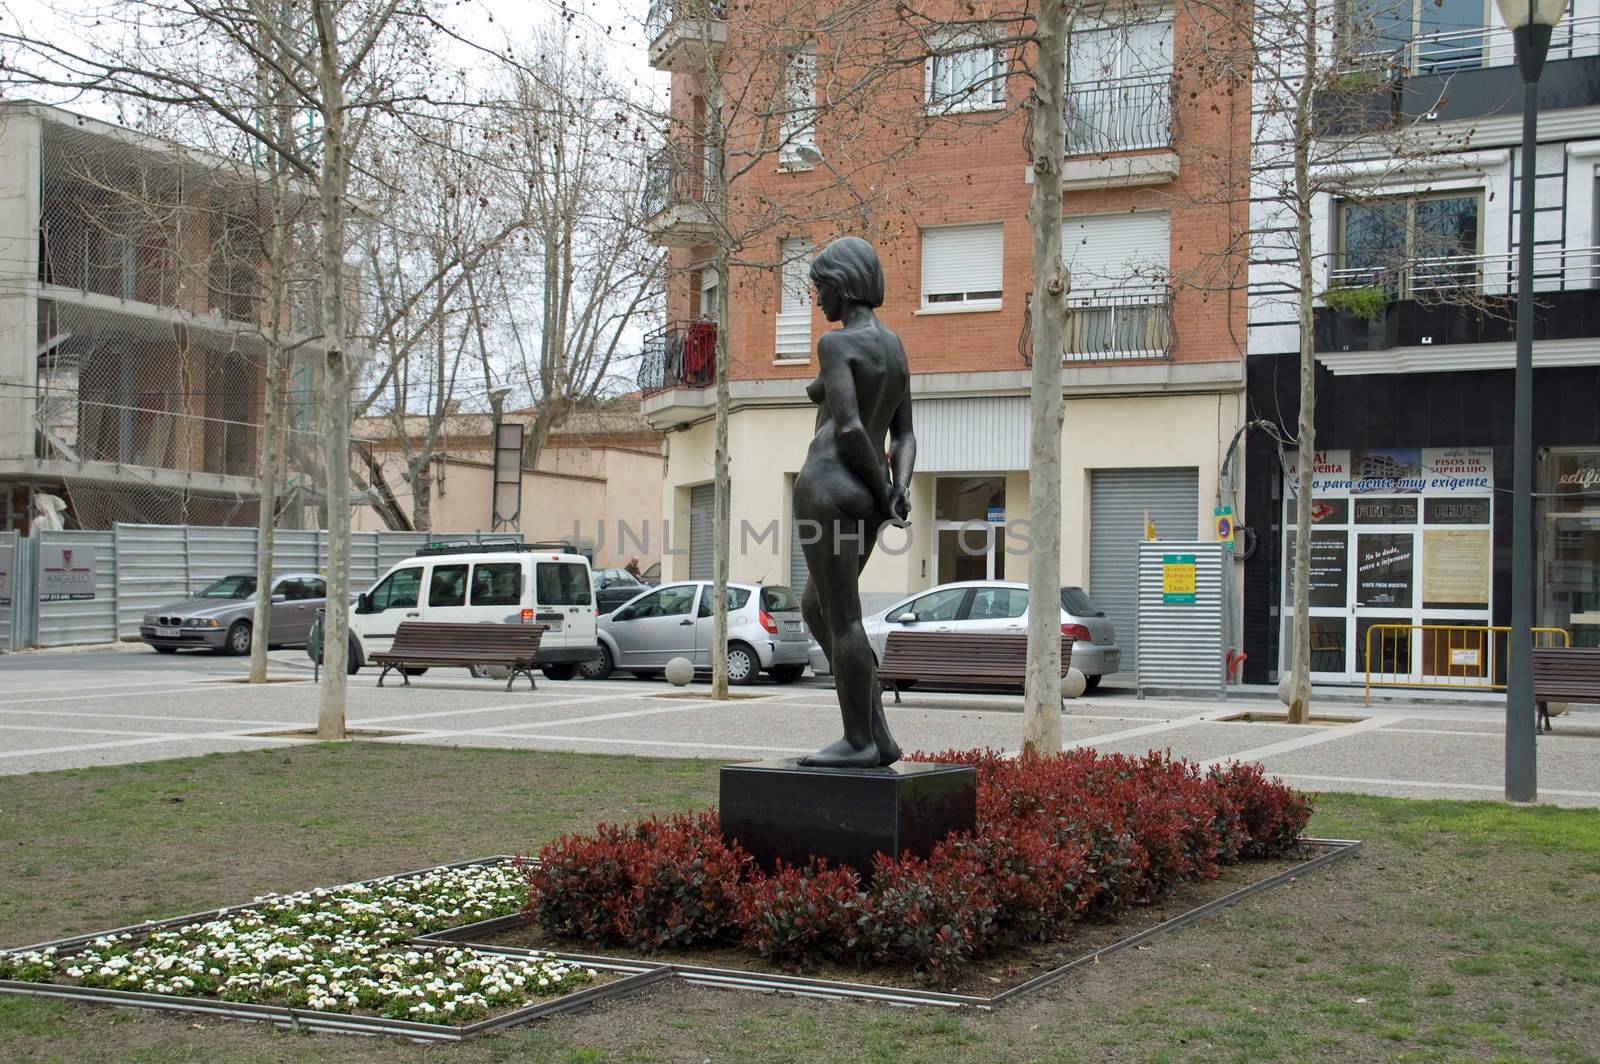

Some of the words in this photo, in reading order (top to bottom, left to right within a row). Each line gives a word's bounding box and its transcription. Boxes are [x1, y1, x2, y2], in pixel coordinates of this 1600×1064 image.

[1312, 463, 1342, 473] venta
[1322, 480, 1352, 491] para
[1357, 478, 1394, 490] gente
[1398, 479, 1427, 490] muy
[1431, 476, 1488, 490] exigente
[1559, 468, 1600, 488] edifi
